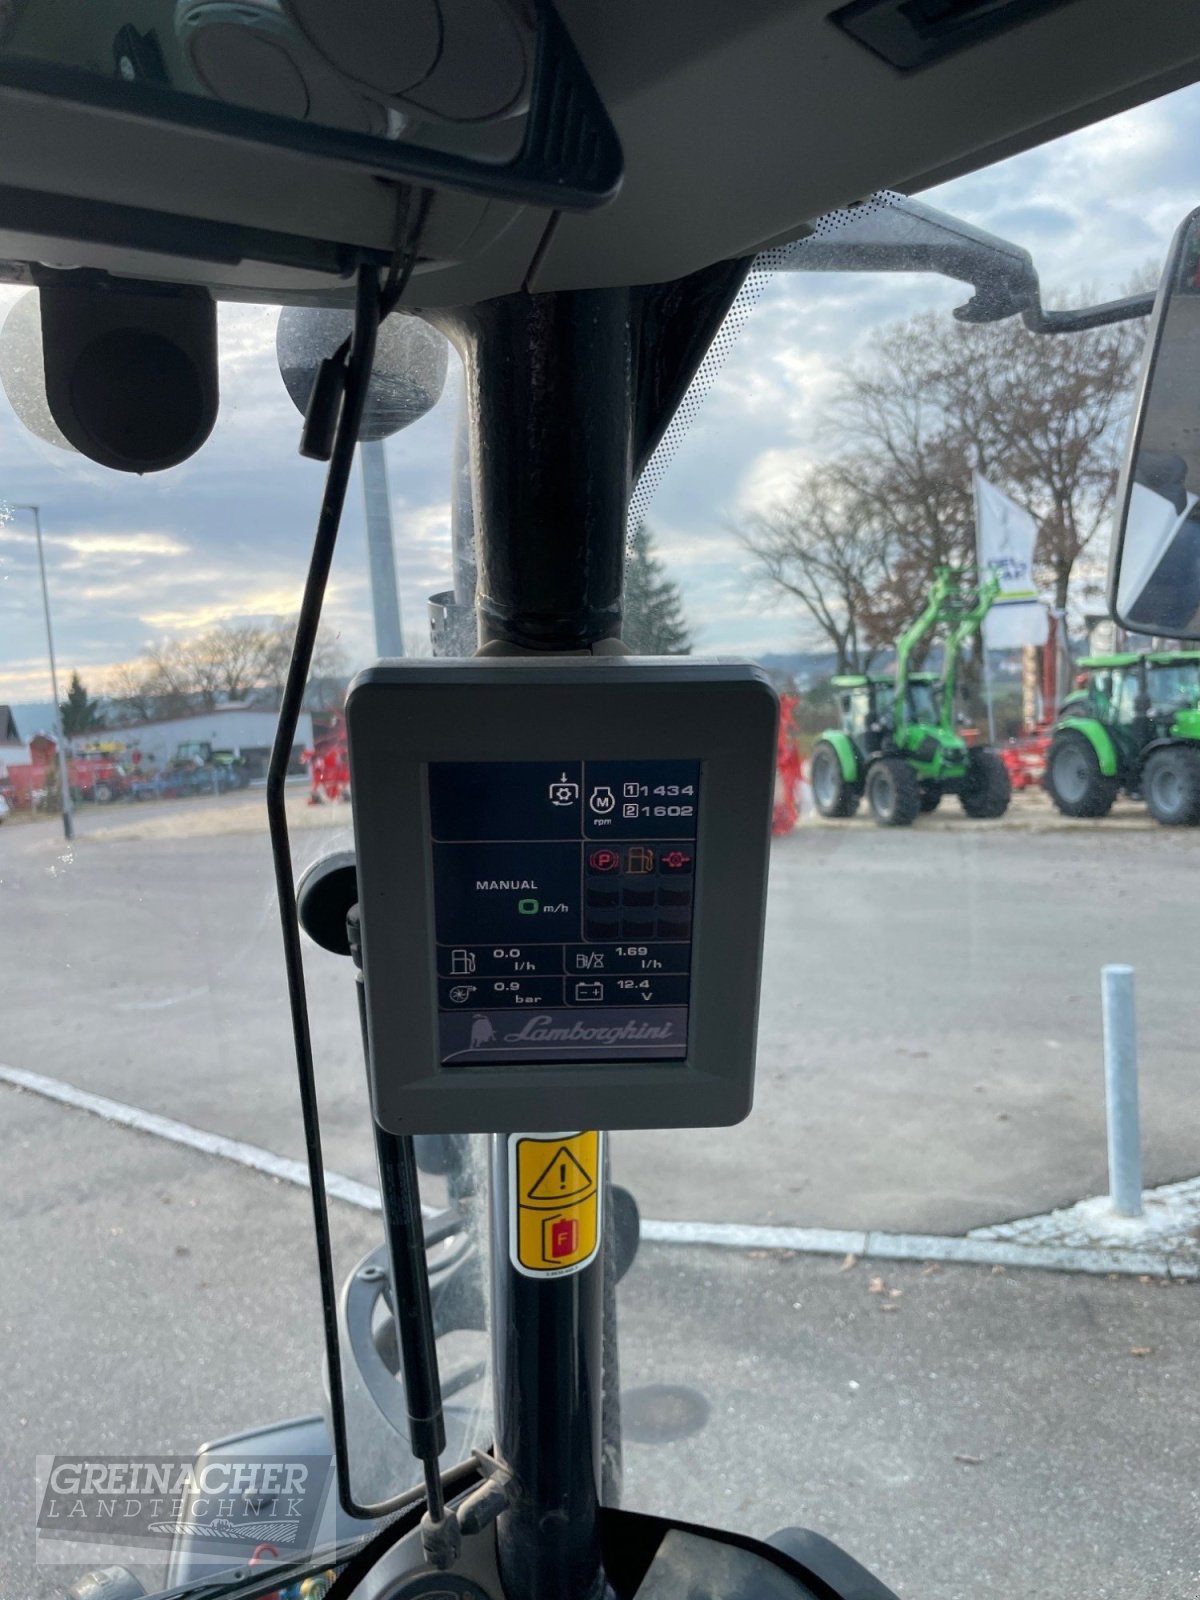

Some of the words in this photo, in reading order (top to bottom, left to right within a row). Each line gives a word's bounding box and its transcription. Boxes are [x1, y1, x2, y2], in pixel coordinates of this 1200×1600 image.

[640, 785, 694, 797] 1434
[596, 797, 609, 808] M
[641, 806, 694, 817] 1602
[475, 880, 538, 890] MANUAL
[518, 899, 539, 915] 0
[543, 904, 569, 913] m/h
[493, 949, 520, 958] 0.0
[615, 947, 648, 956] 1.69
[493, 982, 520, 991] 0.9
[617, 980, 650, 989] 12.4
[515, 995, 542, 1003] bar
[503, 1015, 673, 1045] Lamborghini
[557, 1232, 568, 1246] F
